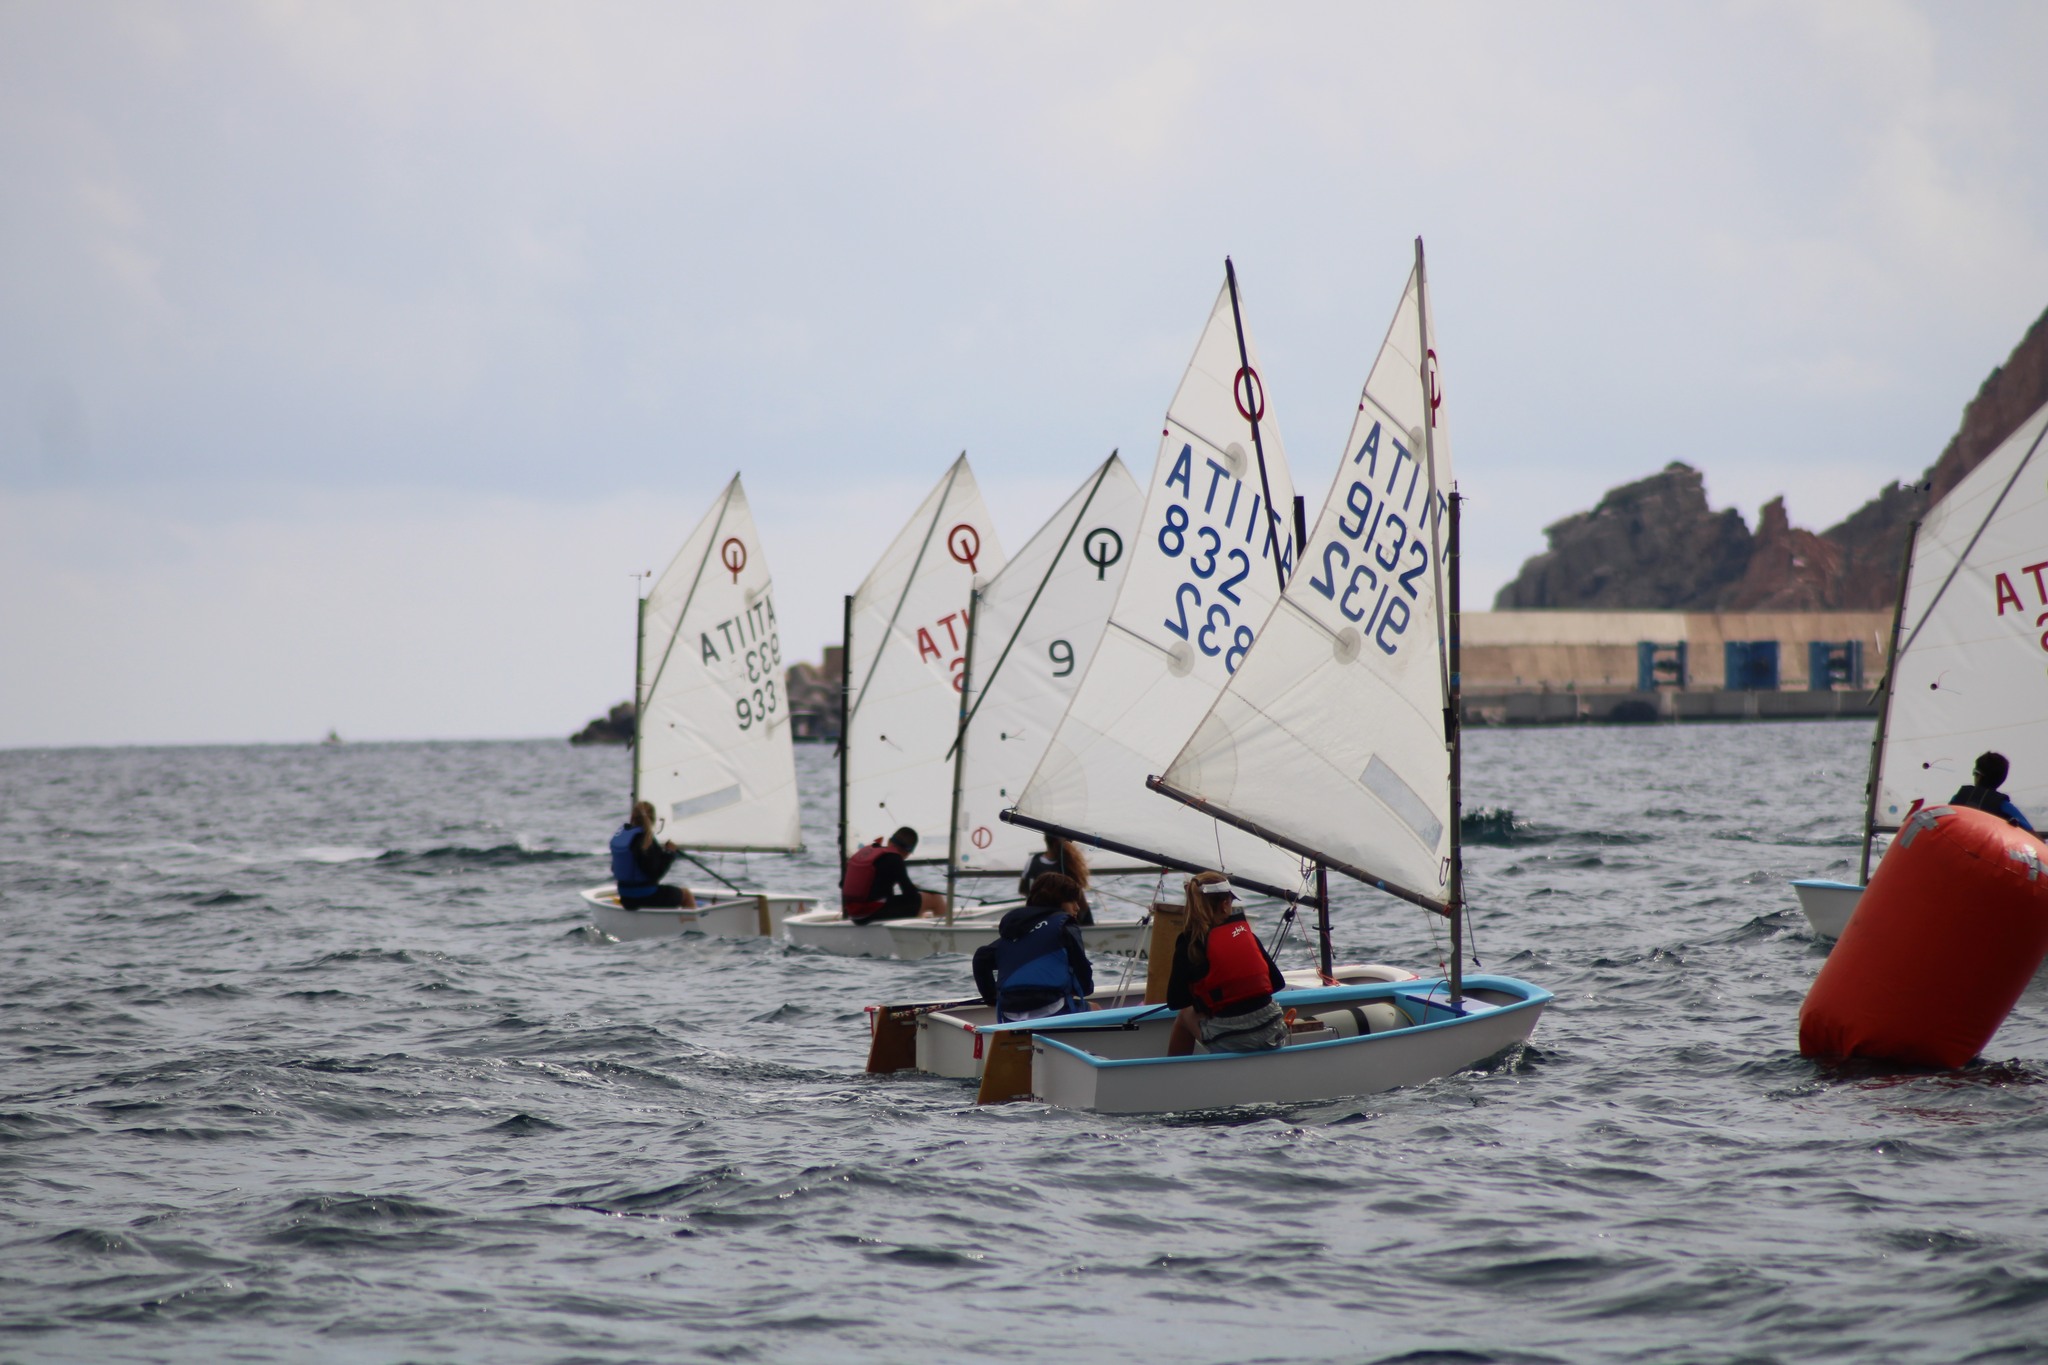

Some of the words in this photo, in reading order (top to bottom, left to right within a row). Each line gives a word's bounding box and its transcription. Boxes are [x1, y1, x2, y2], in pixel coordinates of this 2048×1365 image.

[1158, 504, 1250, 606] 832
[1339, 481, 1429, 600] 9132
[700, 595, 777, 666] ATIITA
[1049, 639, 1075, 678] 9
[736, 680, 777, 730] 933
